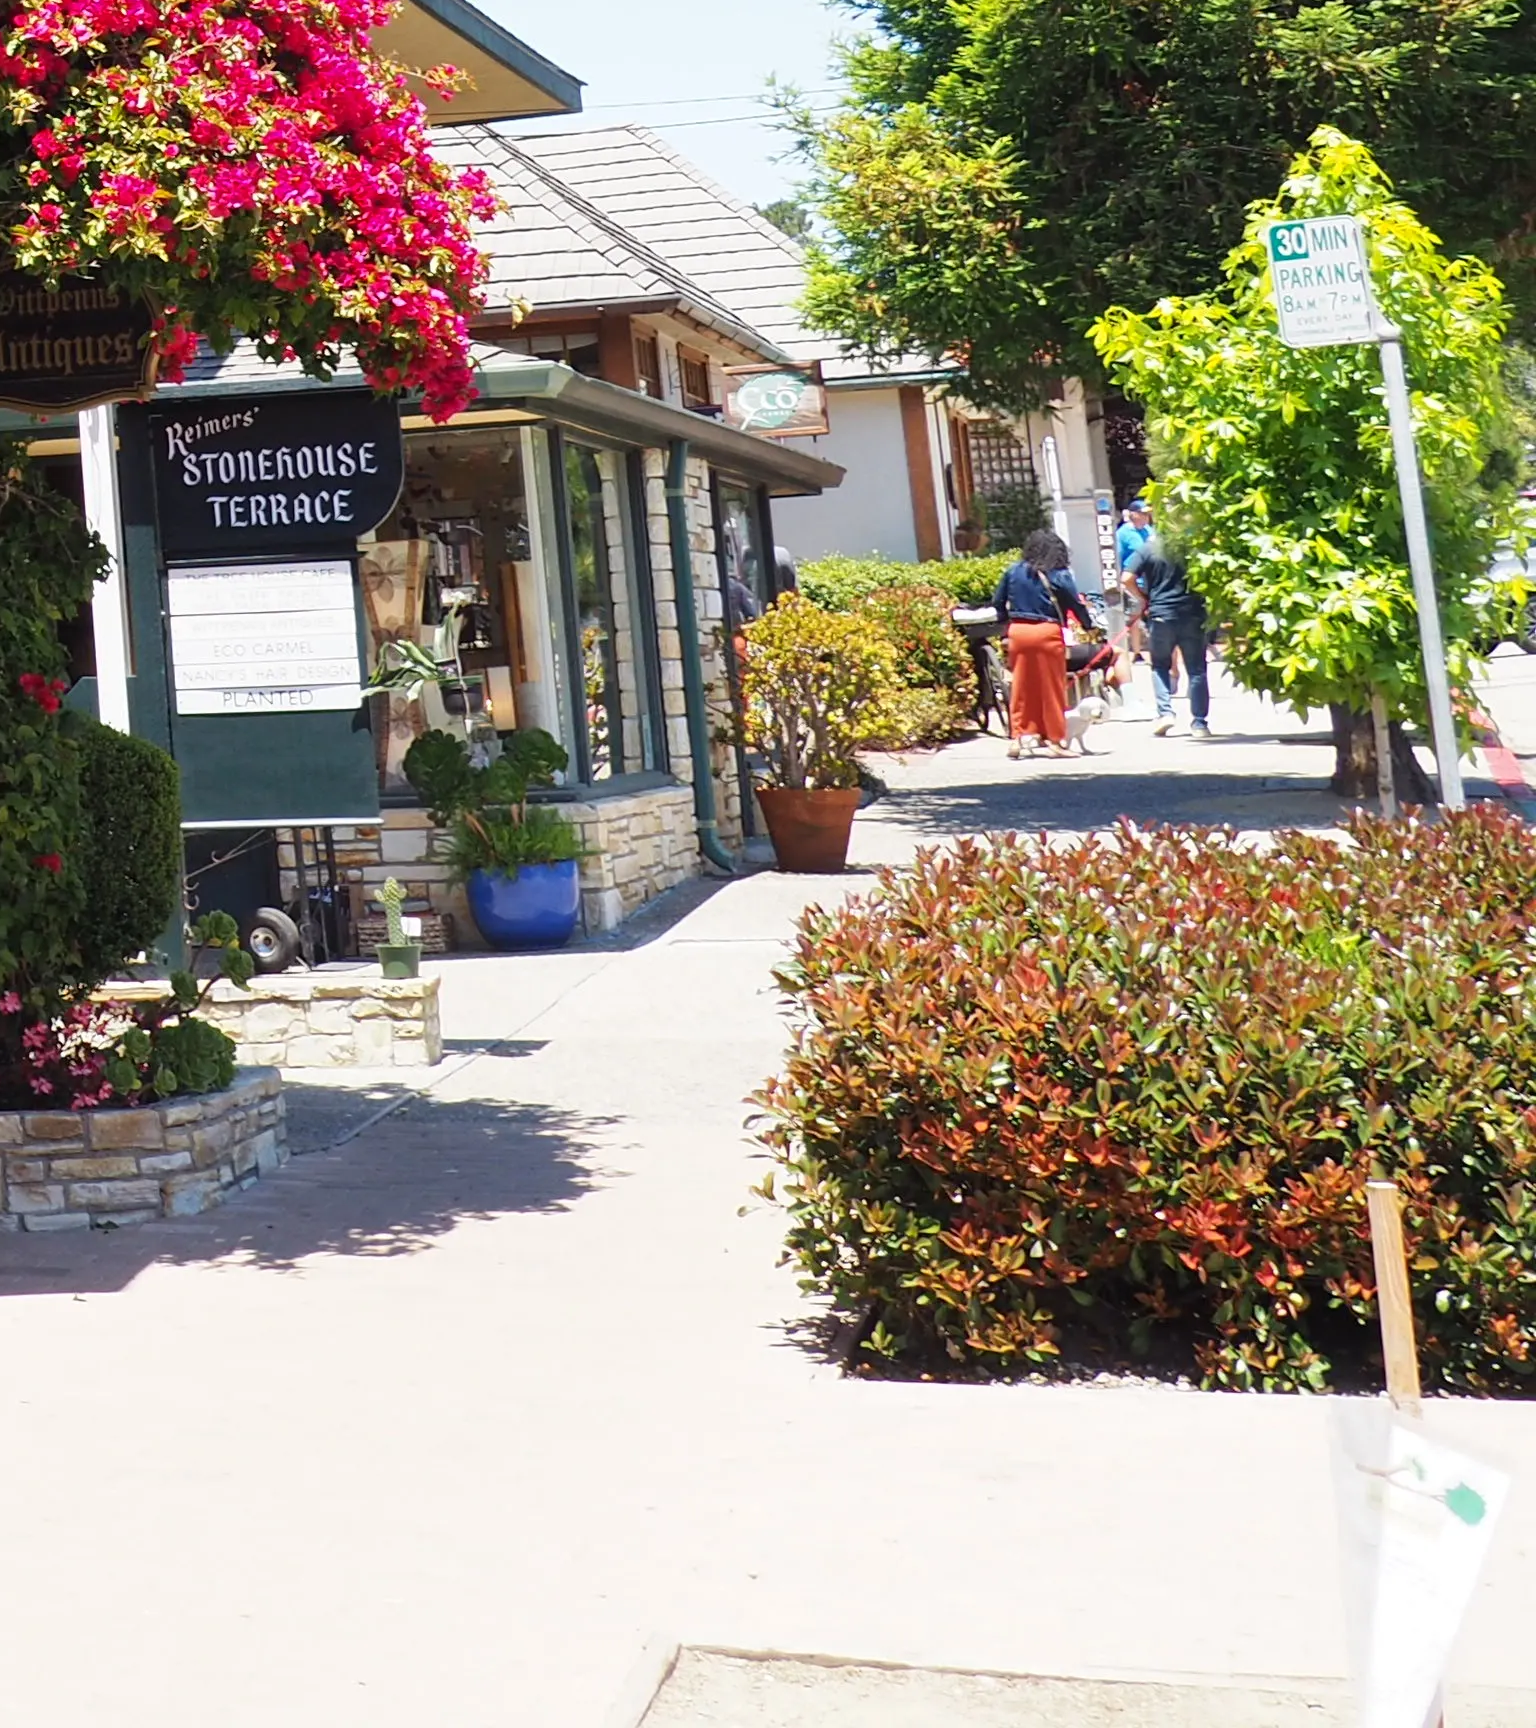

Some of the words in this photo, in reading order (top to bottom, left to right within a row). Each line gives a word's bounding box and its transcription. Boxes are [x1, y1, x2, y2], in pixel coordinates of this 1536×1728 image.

[1276, 226, 1307, 257] 30
[1311, 225, 1347, 252] MIN
[1280, 262, 1360, 290] PARKING
[183, 441, 378, 486] STONEHOUSE
[206, 488, 355, 528] TERRACE
[213, 644, 246, 658] ECO
[252, 641, 314, 656] CARMEL
[297, 664, 353, 679] DESIGN
[223, 689, 314, 708] PLANTED
